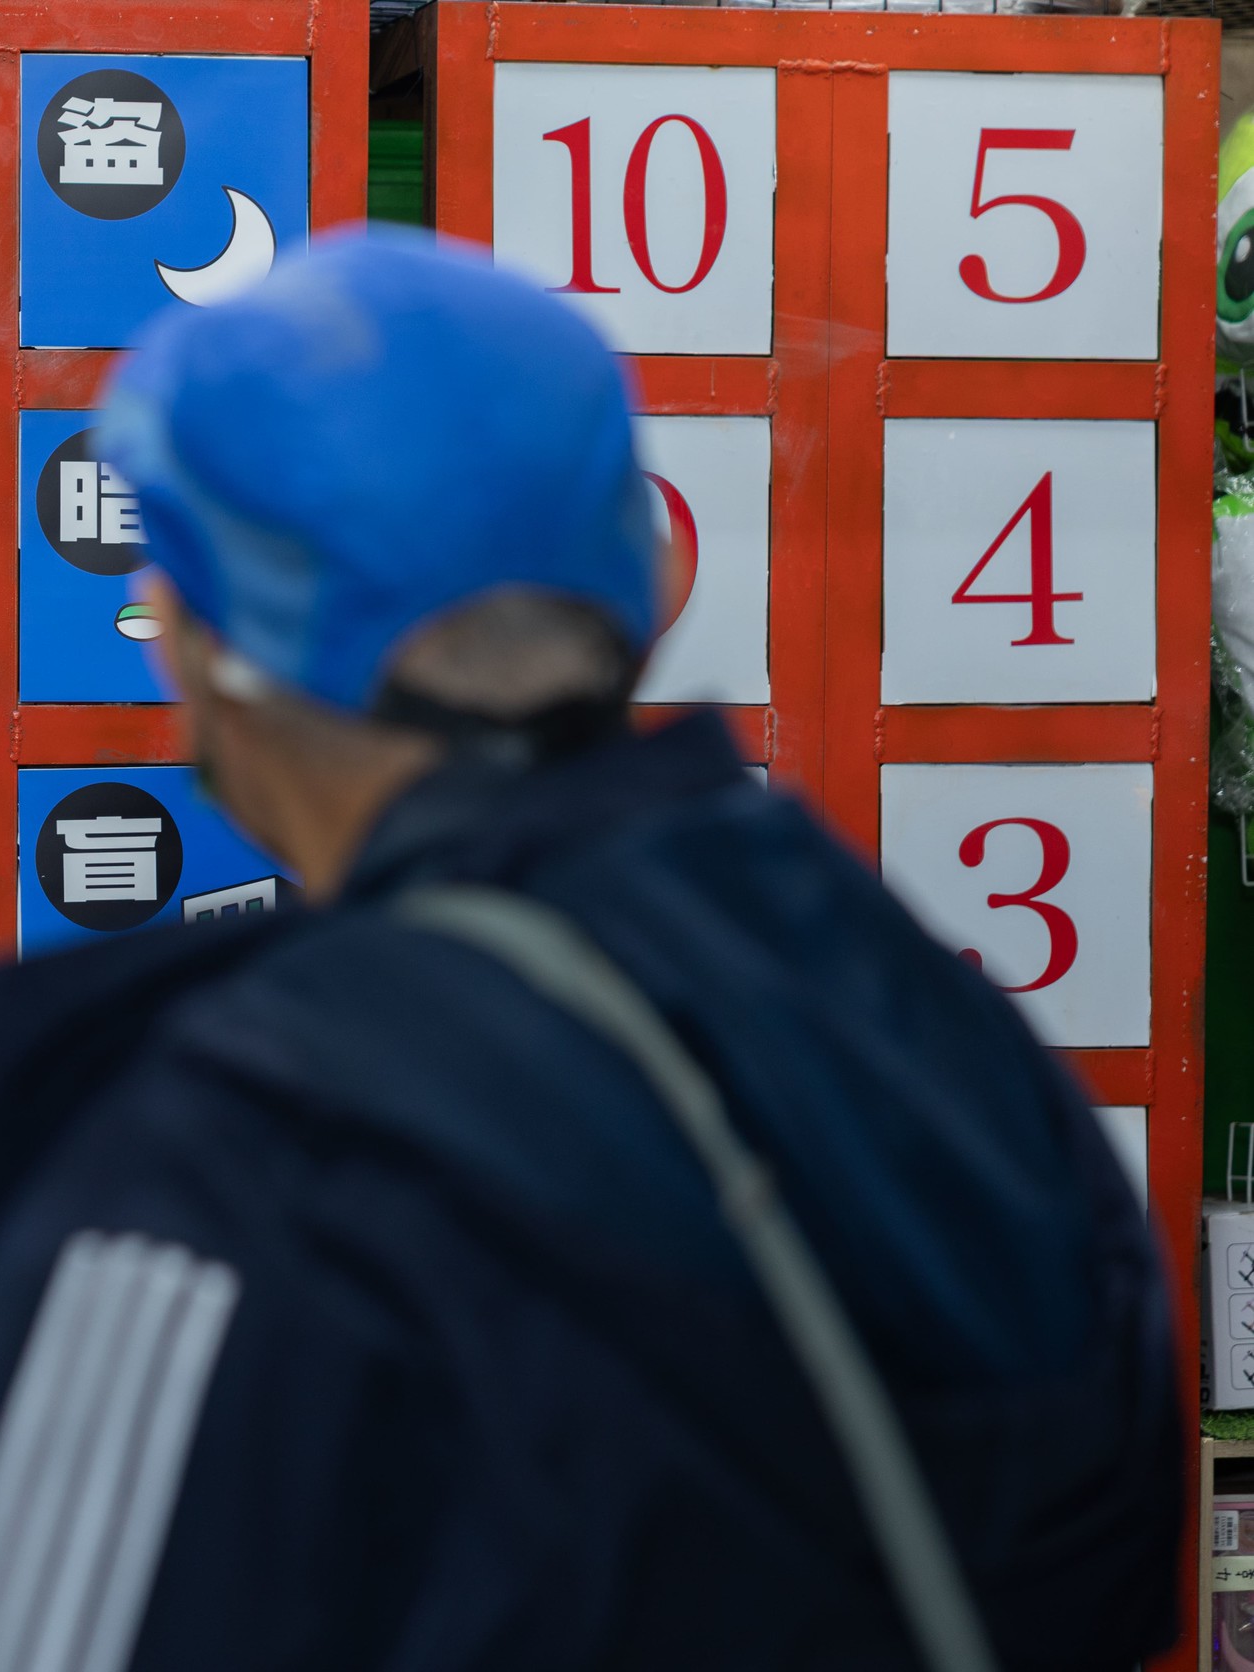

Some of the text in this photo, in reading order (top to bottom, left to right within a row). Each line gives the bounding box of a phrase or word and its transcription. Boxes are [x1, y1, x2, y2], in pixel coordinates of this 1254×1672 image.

[57, 96, 164, 186] 盜
[542, 113, 727, 294] 10
[958, 127, 1087, 304] 5
[951, 470, 1084, 647] 4
[56, 815, 162, 903] 盲
[957, 816, 1079, 994] 3
